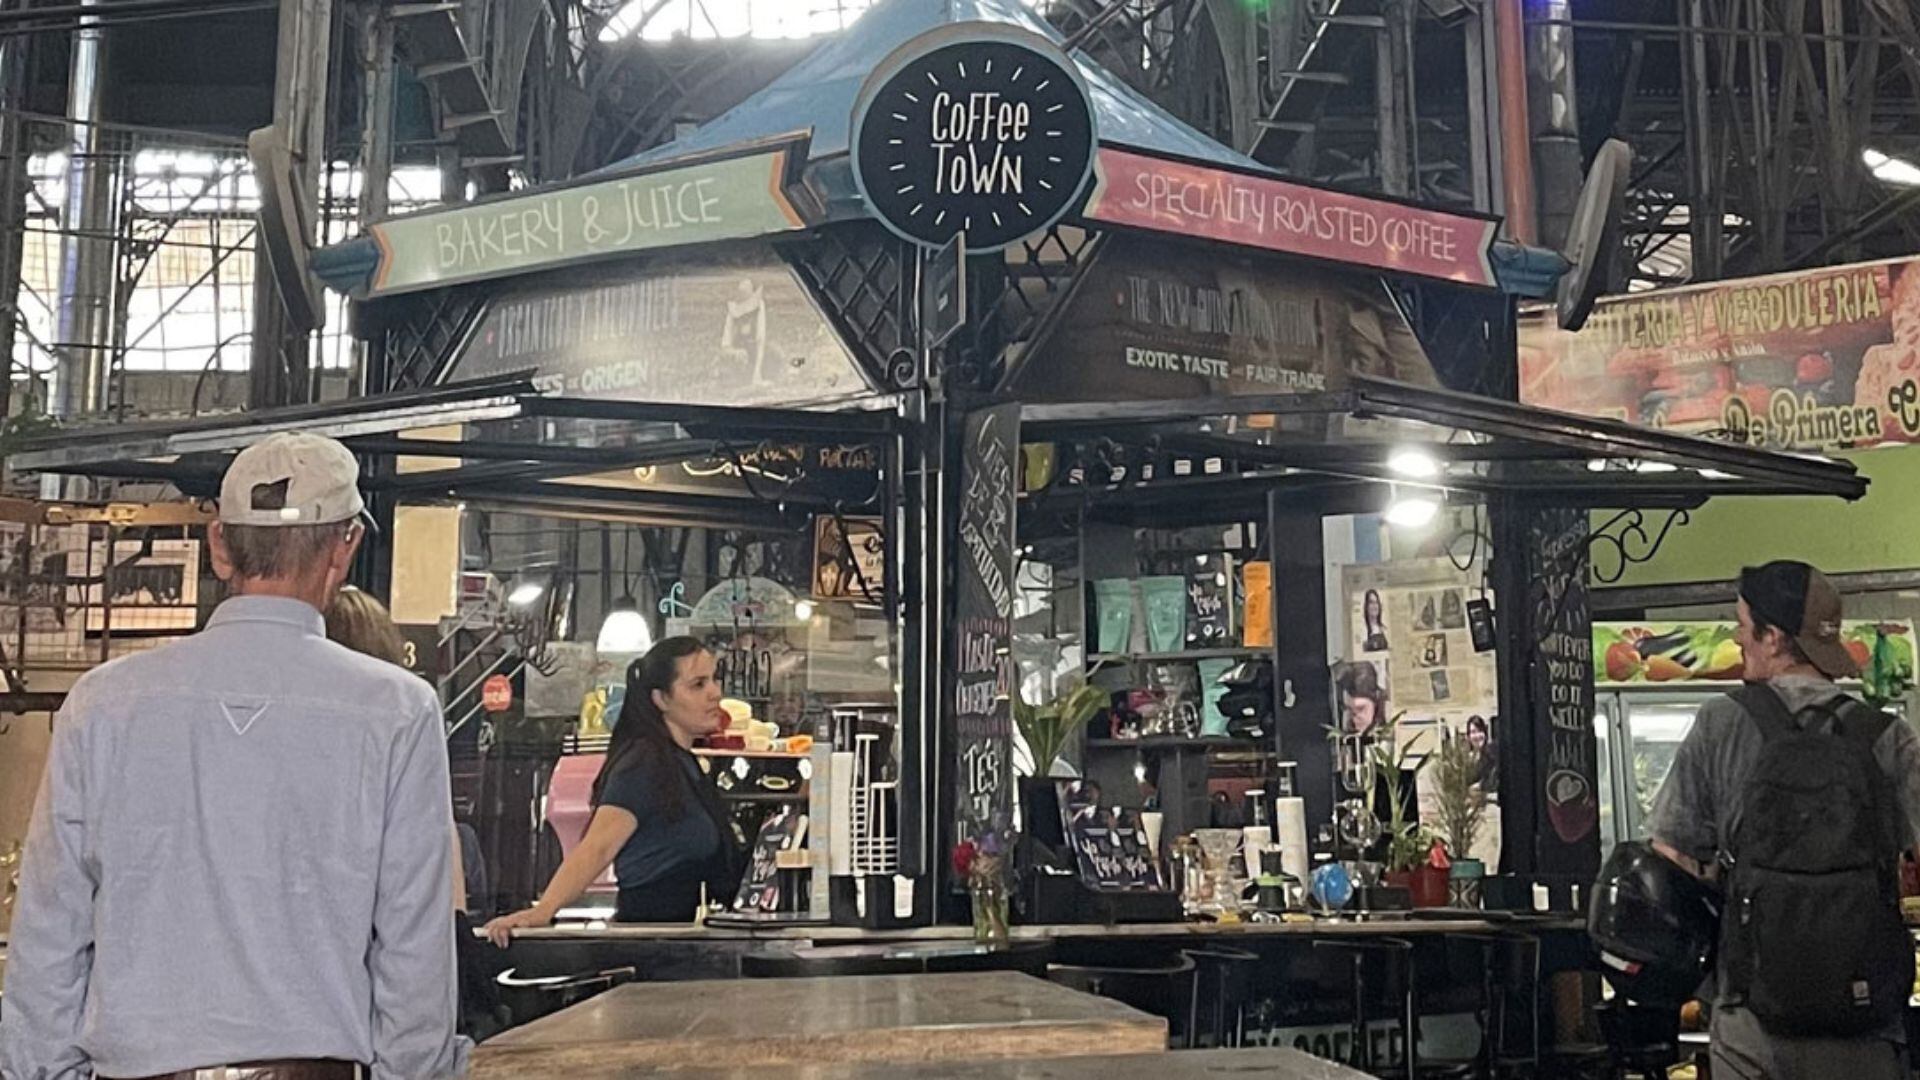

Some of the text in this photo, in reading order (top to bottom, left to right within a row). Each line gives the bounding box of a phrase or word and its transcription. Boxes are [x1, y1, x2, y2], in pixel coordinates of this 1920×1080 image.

[437, 177, 722, 269] BAKERY & JUICE
[1132, 170, 1457, 263] SPECIALTY ROASTED COFFEE
[1587, 272, 1883, 351] UTERIA Y VERDULERIA
[581, 359, 649, 393] ORIGEN
[1126, 346, 1230, 379] EXOTIC TASTE
[1246, 363, 1326, 392] FAIR TRADE
[1770, 388, 1882, 446] Primera
